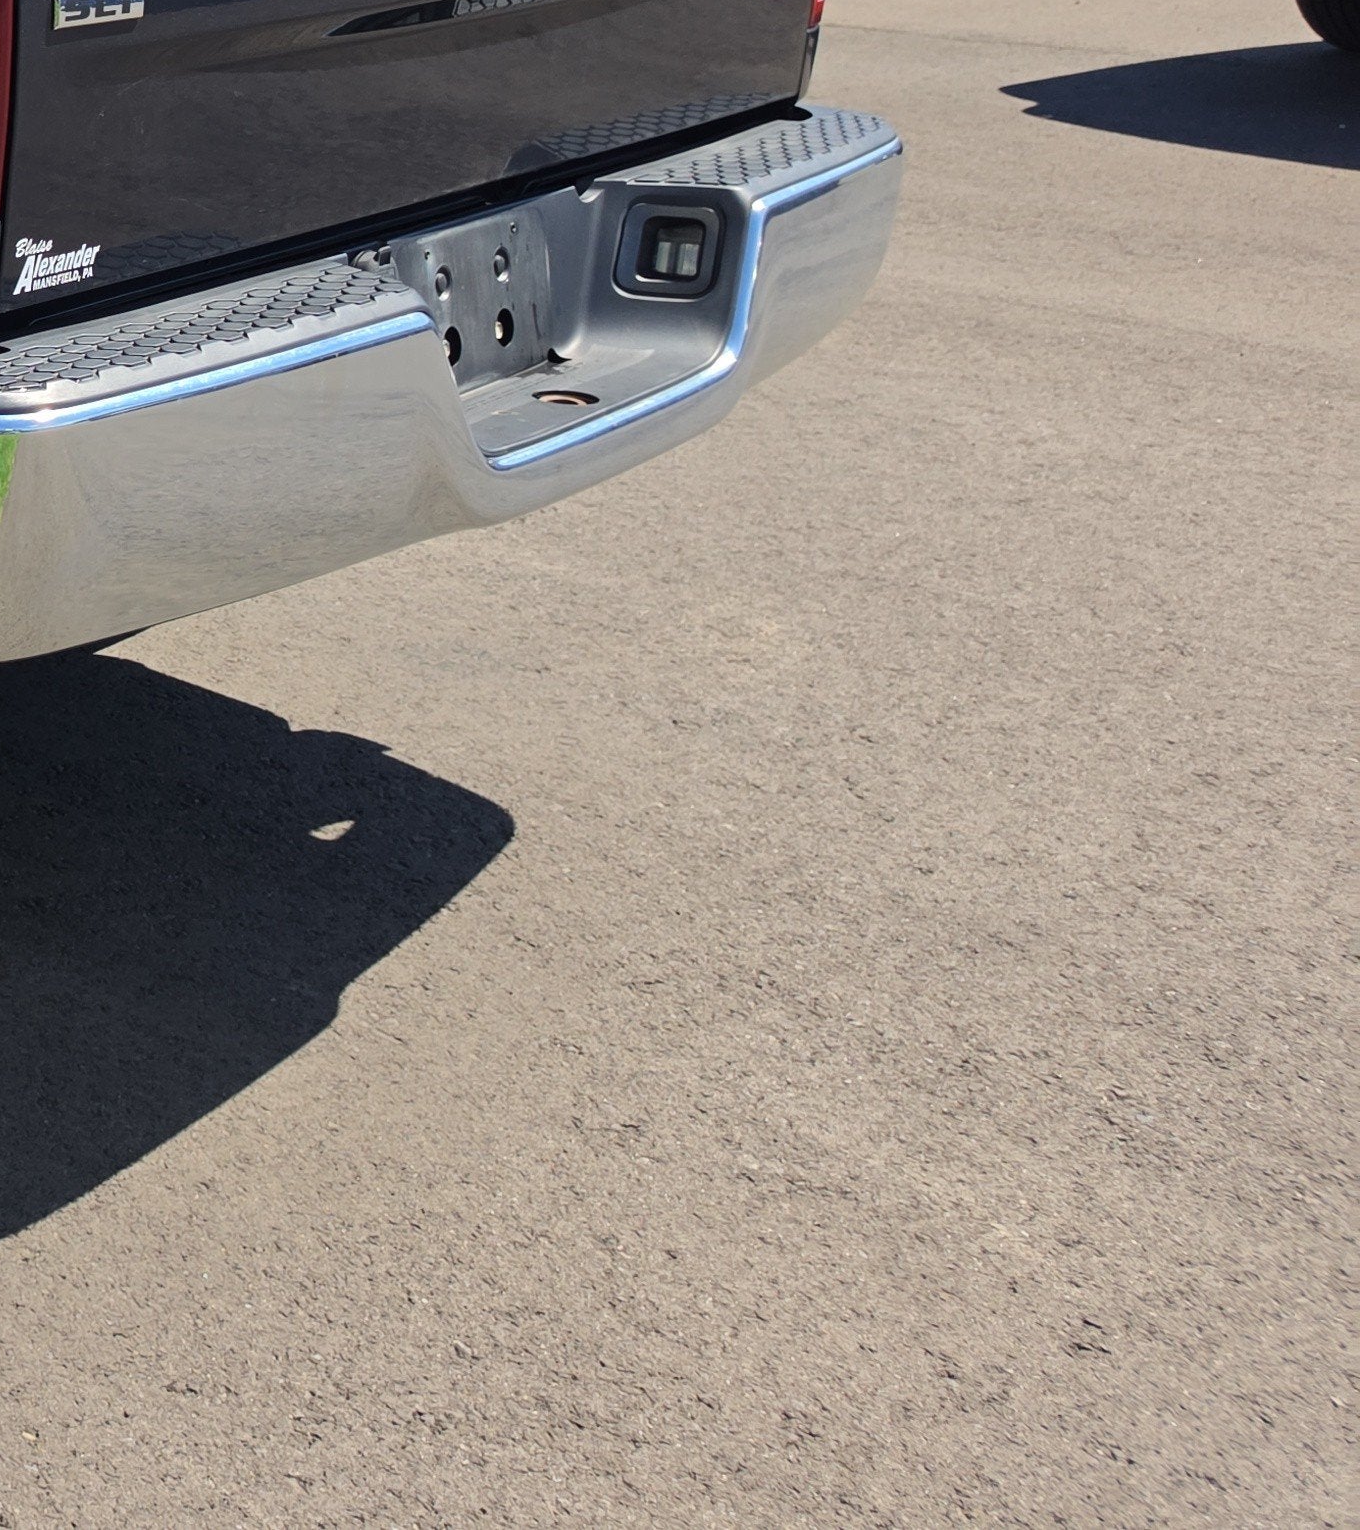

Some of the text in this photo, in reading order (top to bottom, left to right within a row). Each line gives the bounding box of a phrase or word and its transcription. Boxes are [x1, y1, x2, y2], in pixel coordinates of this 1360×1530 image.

[15, 237, 53, 258] Blaise
[12, 243, 101, 296] Alexander
[32, 266, 94, 291] MANSFIELD, PA
